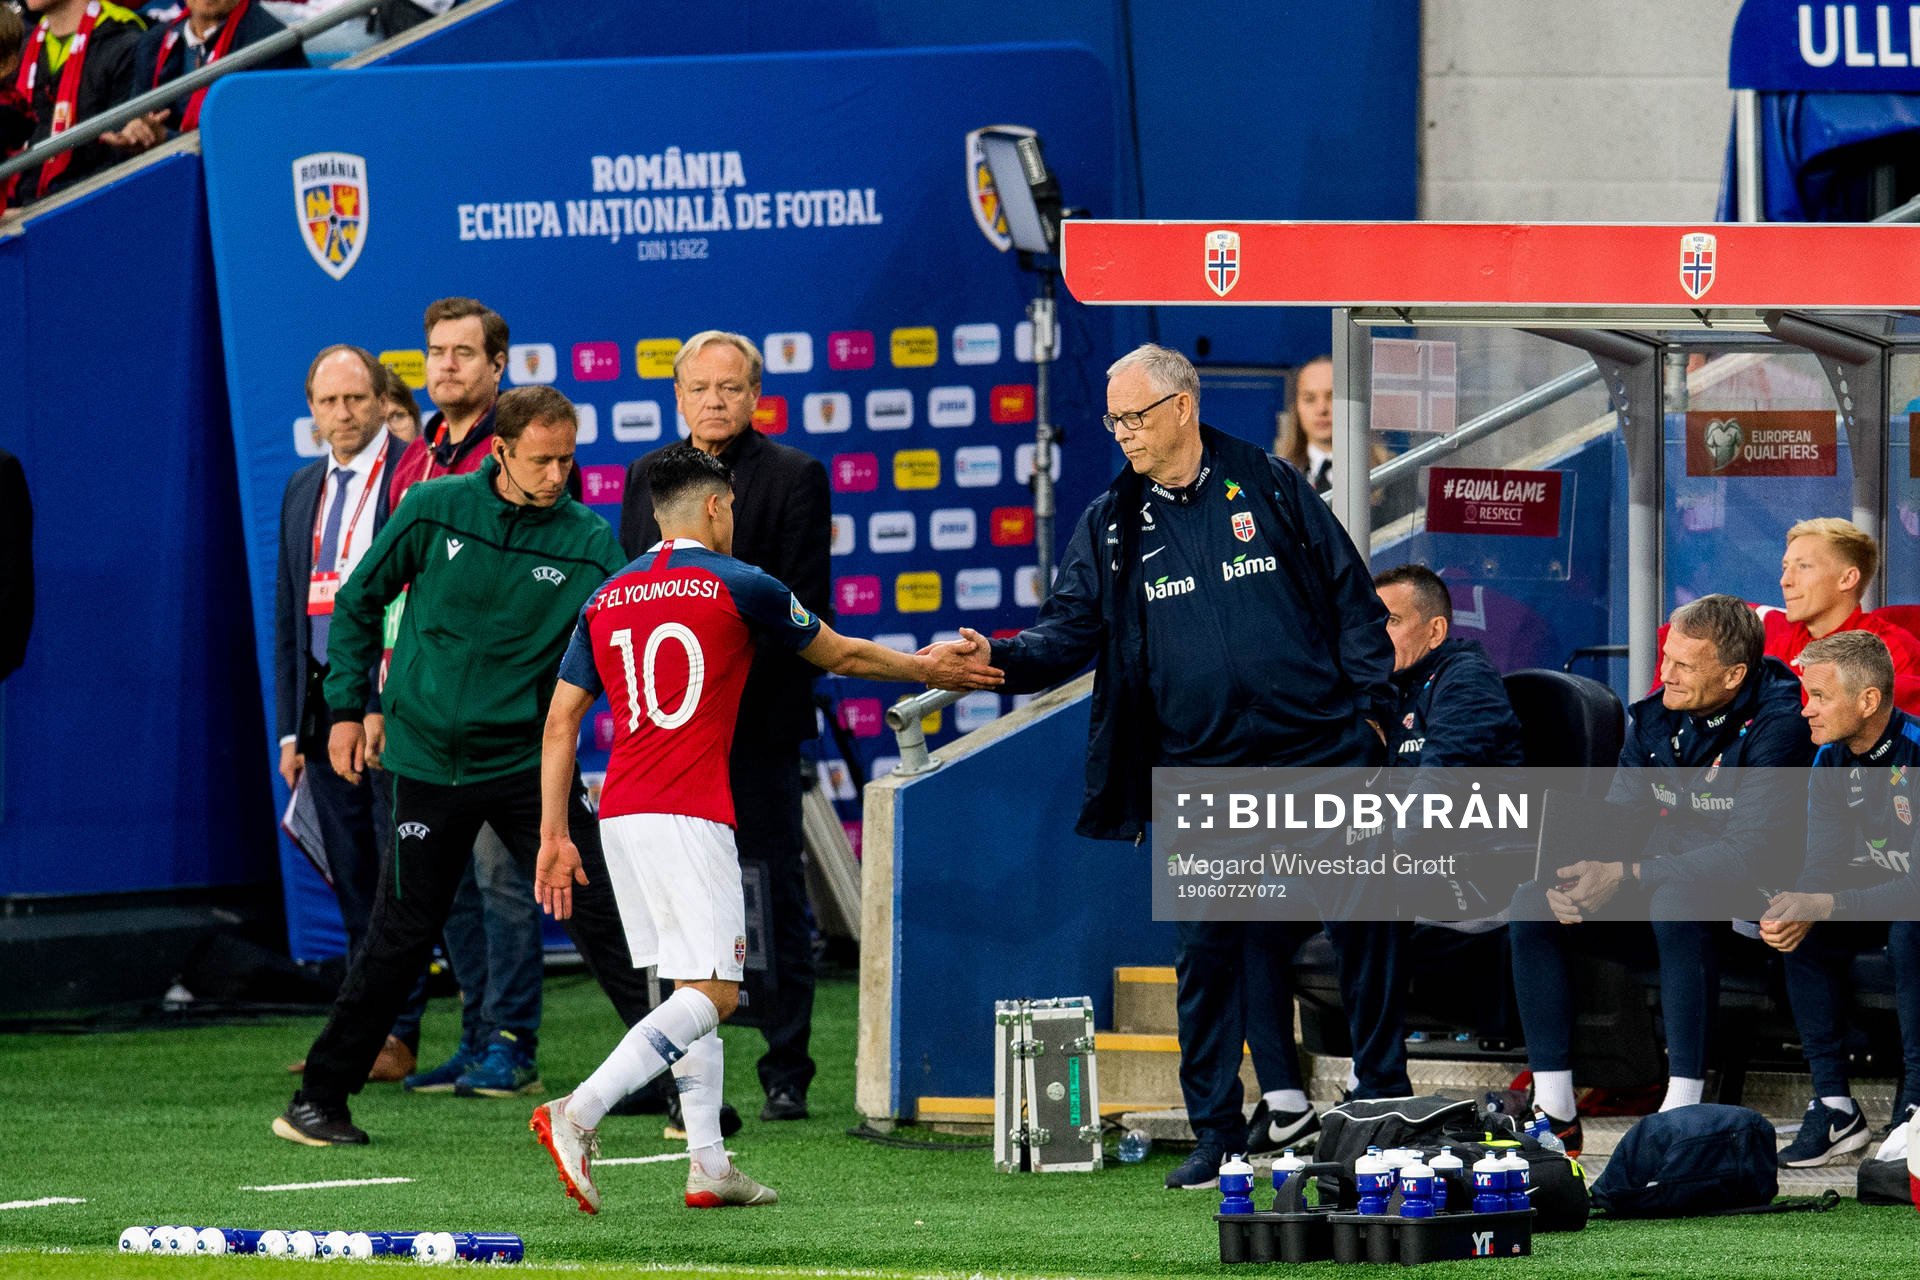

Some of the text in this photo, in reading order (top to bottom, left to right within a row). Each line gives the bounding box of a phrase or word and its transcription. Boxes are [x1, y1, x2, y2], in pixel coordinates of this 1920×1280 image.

[592, 146, 745, 192] ROMÂNIA
[459, 201, 562, 241] ECHIPA
[735, 193, 772, 230] DE
[777, 189, 883, 228] FOTBAL
[638, 238, 709, 261] DIN 1922
[1752, 430, 1811, 443] EUROPEAN
[1744, 444, 1819, 461] QUALIFIERS
[1444, 479, 1547, 503] #EQUAL GAME
[1479, 506, 1523, 521] RESPECT
[532, 567, 565, 585] UEFA
[607, 578, 719, 609] ELYOUNOUSSI
[610, 621, 705, 733] 10
[1471, 1231, 1494, 1256] YT
